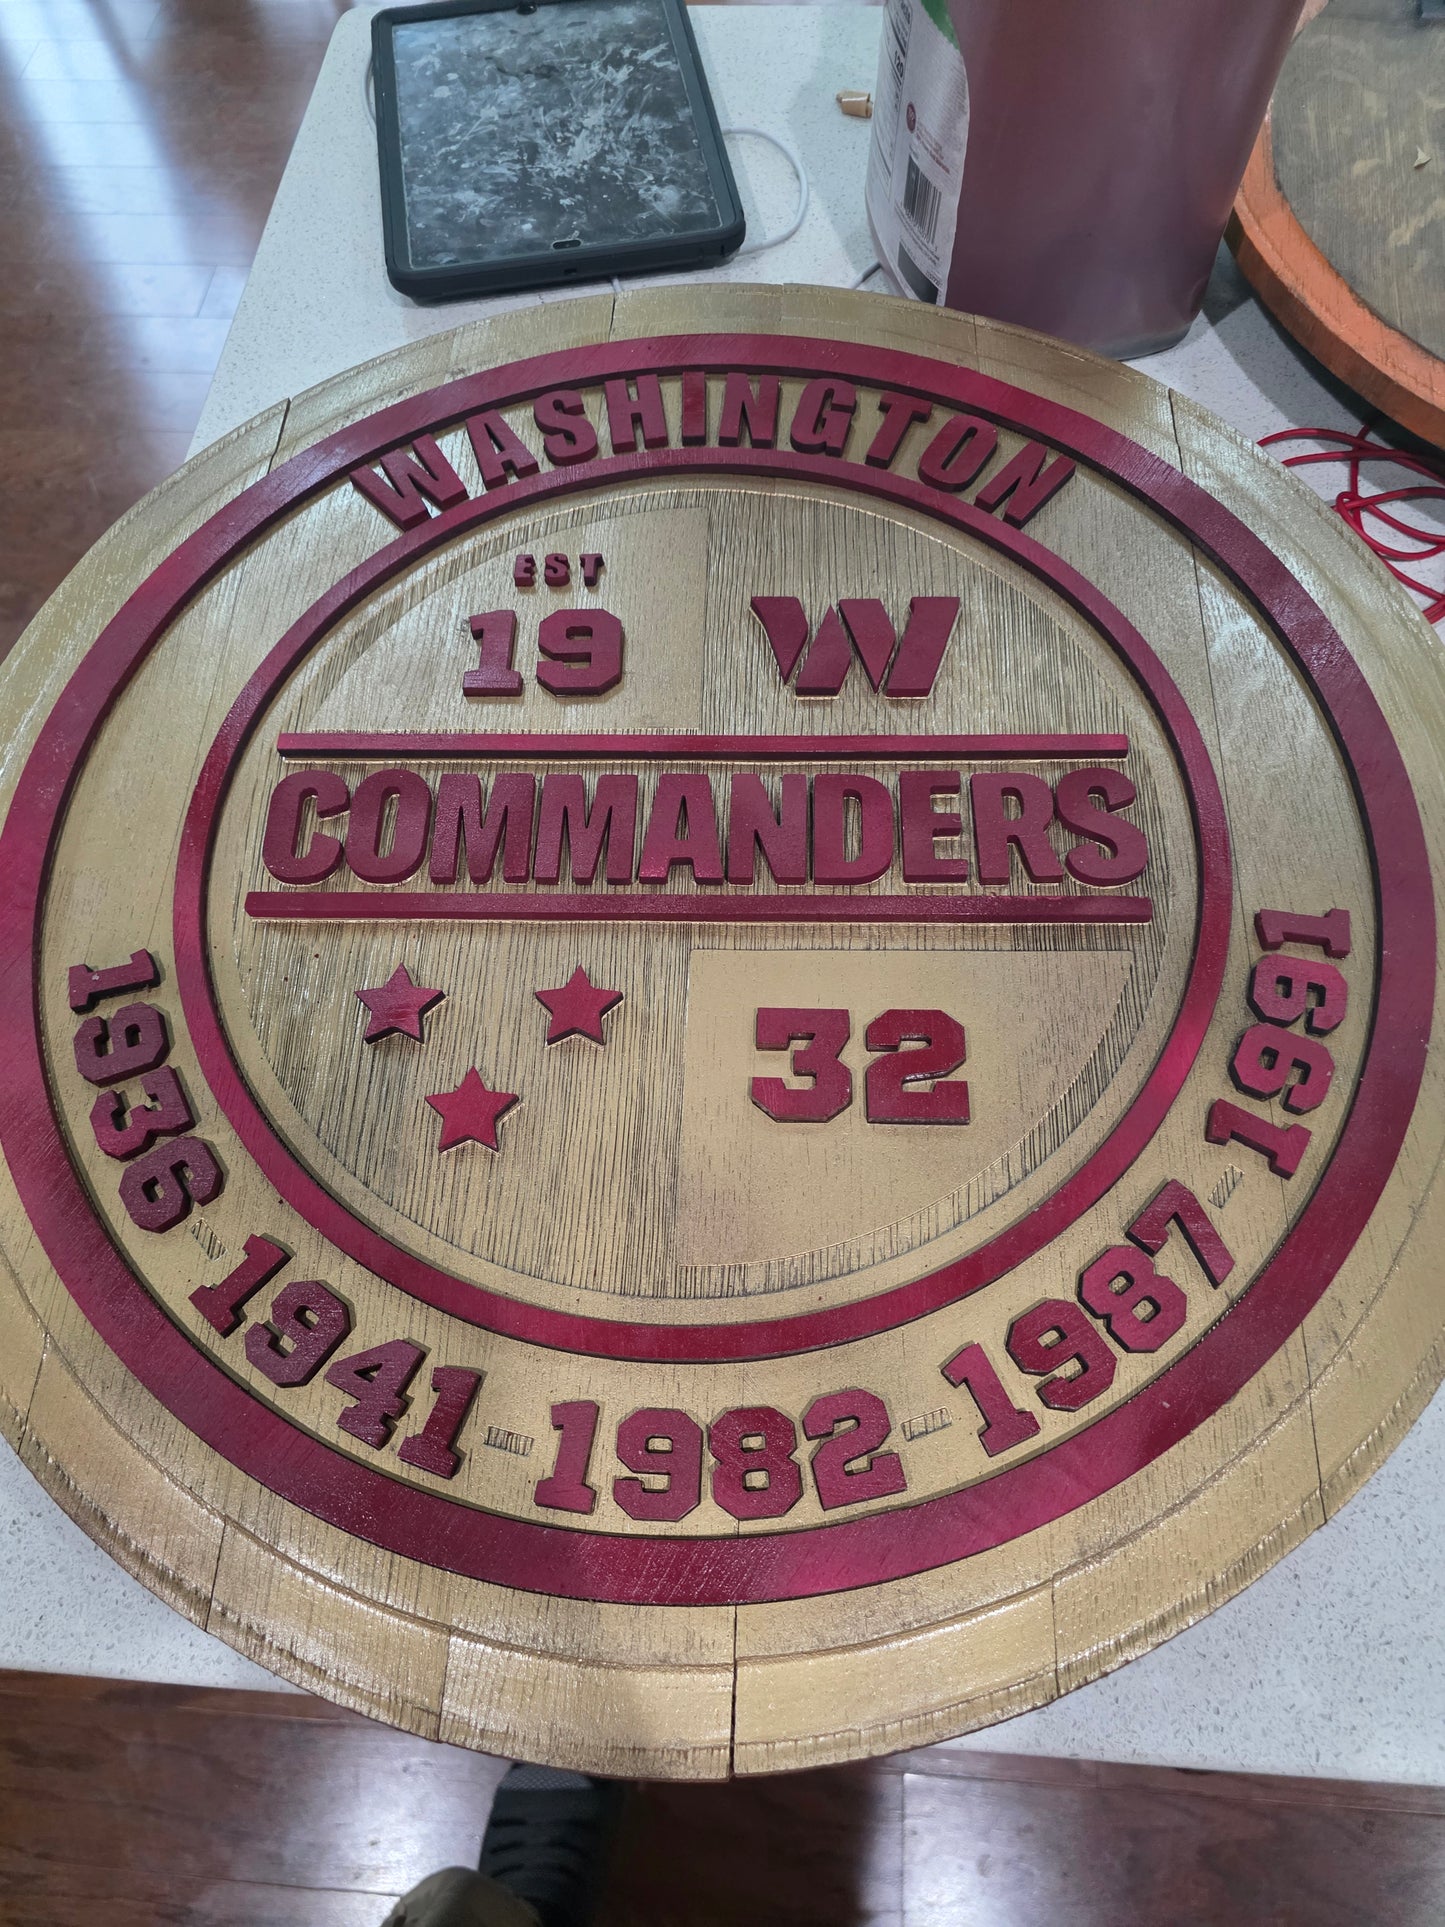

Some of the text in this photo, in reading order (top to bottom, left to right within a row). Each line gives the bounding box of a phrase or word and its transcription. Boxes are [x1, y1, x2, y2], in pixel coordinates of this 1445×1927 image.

[350, 370, 1076, 530] WASHINGTON
[513, 553, 605, 588] EST
[462, 608, 625, 697] 19
[750, 596, 960, 697] W
[262, 766, 1149, 887] COMMANDERS
[751, 1007, 971, 1124] 32
[534, 1387, 907, 1521] 1982
